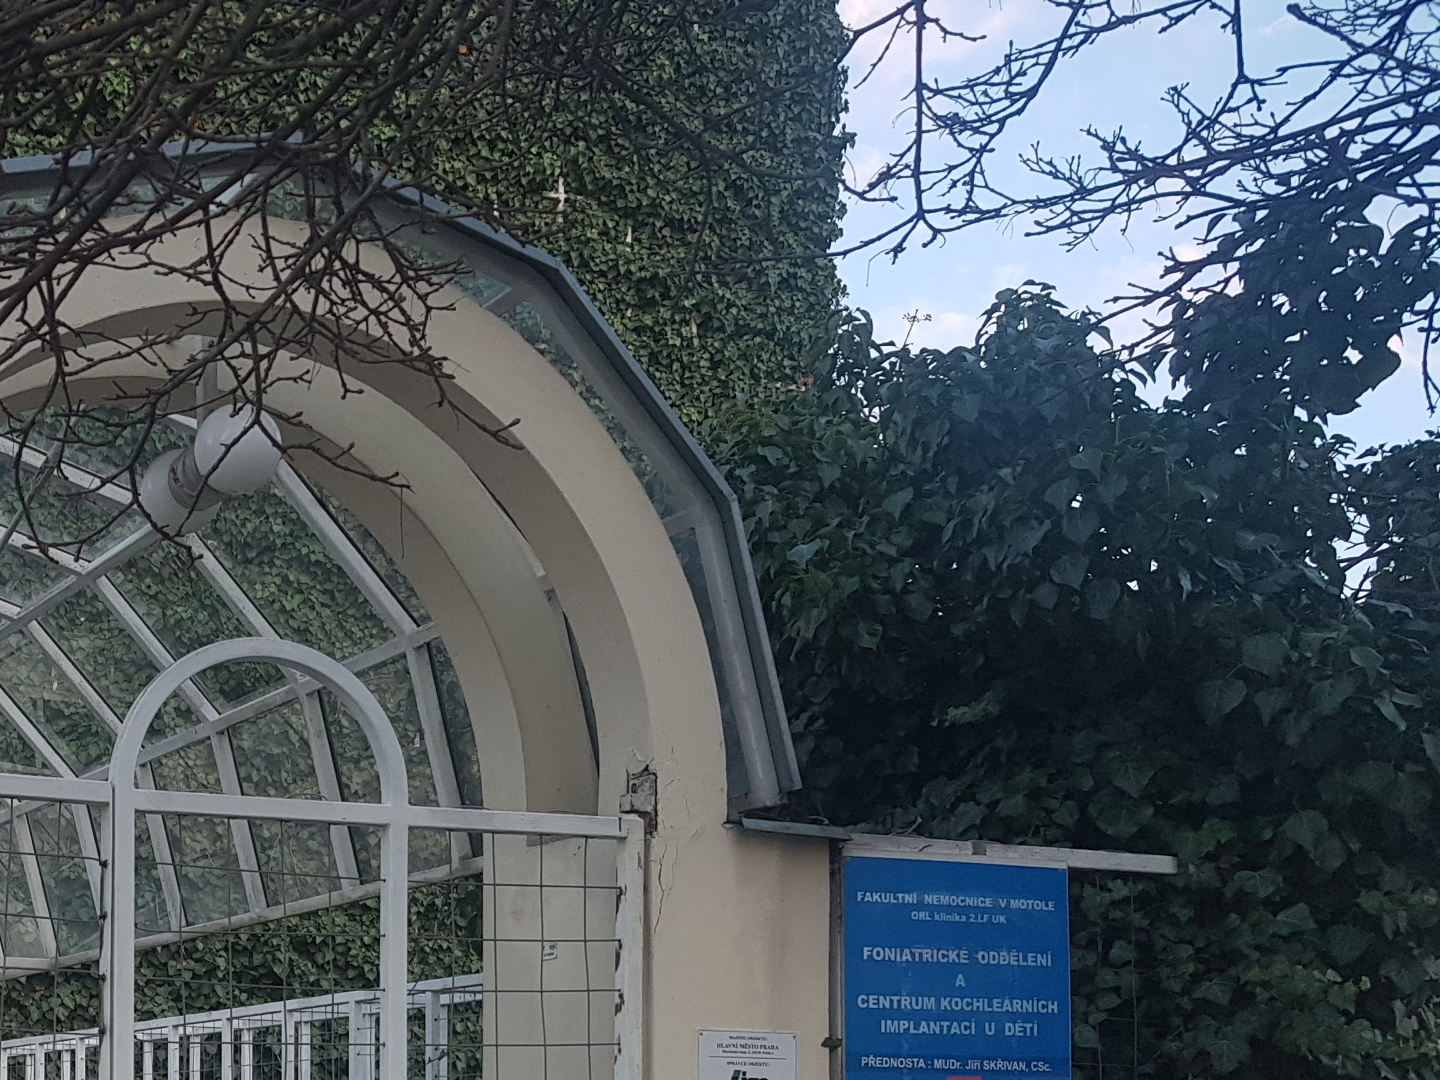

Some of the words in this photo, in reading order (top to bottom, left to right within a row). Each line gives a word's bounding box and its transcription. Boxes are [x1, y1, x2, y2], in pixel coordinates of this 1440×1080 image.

[857, 891, 917, 904] FAKULTNÍ
[924, 894, 993, 908] NEMOCNICE
[999, 898, 1007, 908] V
[1010, 899, 1055, 910] MOTOLE
[911, 911, 932, 921] ORL
[934, 911, 966, 922] klinika
[992, 914, 1007, 924] UK
[863, 946, 969, 964] FONIATRICKÉ
[978, 949, 1051, 967] ODDĚLENÍ
[955, 974, 966, 987] A
[857, 994, 936, 1010] CENTRUM
[940, 996, 1058, 1013] KOCHLEÁRNÍCH
[881, 1018, 975, 1035] IMPLANTACÍ
[985, 1022, 995, 1035] U
[1005, 1019, 1038, 1036] DĚTÍ
[861, 1054, 925, 1069] PŘEDNOSTA
[934, 1059, 963, 1069] MUDr.
[965, 1059, 980, 1070] Jiří
[983, 1058, 1029, 1072] SKŘIVAN,
[1031, 1061, 1052, 1072] CSc.
